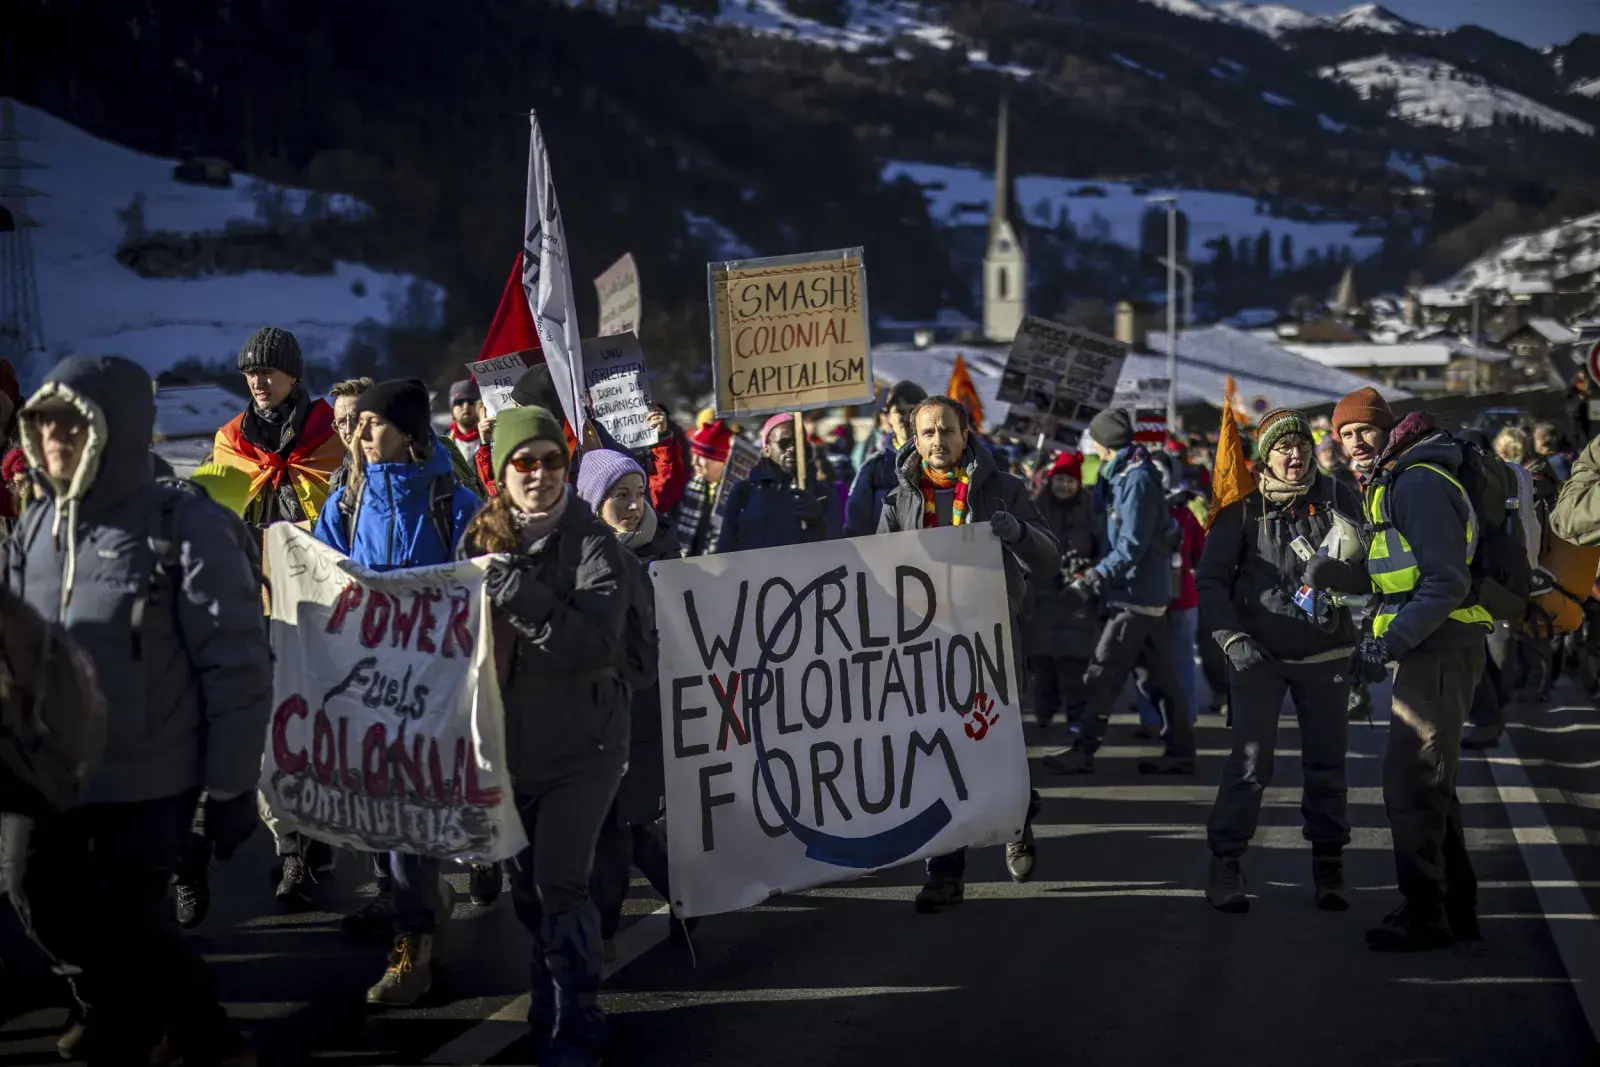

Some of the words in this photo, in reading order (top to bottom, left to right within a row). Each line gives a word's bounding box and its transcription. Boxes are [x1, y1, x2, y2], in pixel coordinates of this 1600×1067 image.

[739, 276, 848, 318] SMASH
[601, 348, 623, 360] UND
[735, 318, 853, 359] COLONIAL
[587, 360, 646, 385] VERLETZTEN
[597, 387, 623, 400] DURCH
[628, 381, 644, 392] DIE
[728, 357, 865, 397] CAPITALISM
[325, 580, 475, 658] POWER
[683, 565, 938, 670] WORLD
[672, 623, 1009, 758] EXPLOITATION
[699, 727, 968, 851] FORUM
